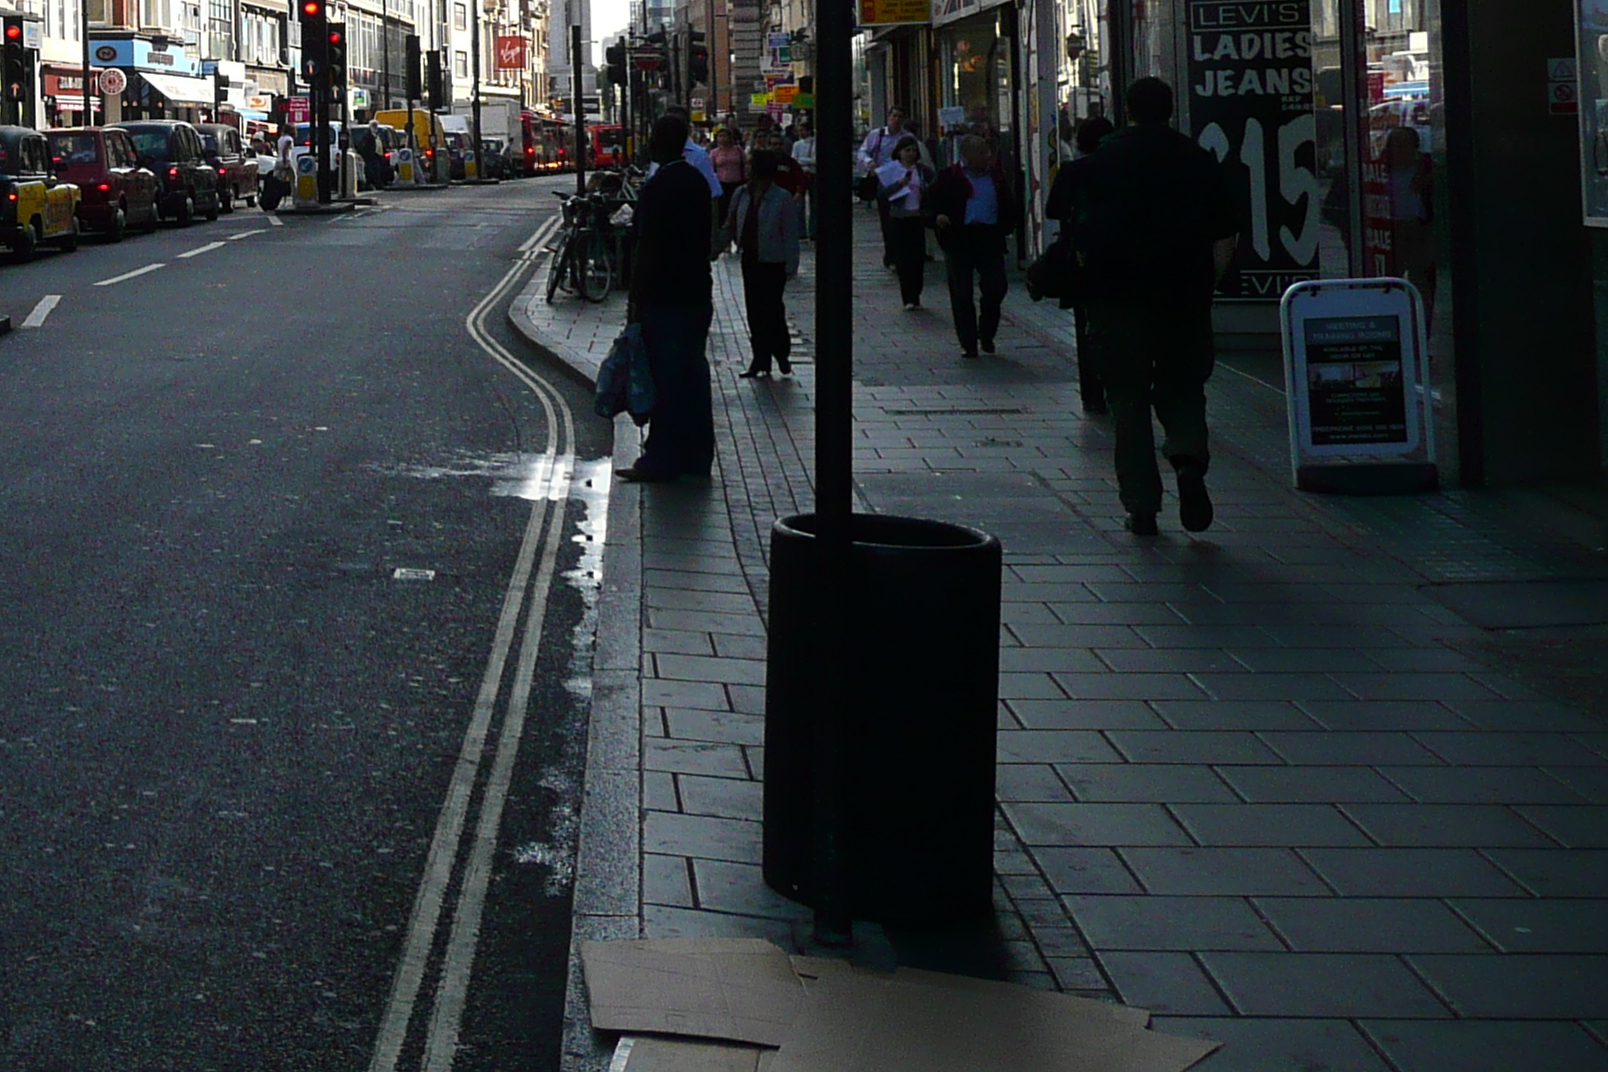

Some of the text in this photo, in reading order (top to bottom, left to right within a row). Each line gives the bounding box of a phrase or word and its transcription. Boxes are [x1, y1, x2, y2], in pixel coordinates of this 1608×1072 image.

[1199, 2, 1300, 27] LEVI'S
[1194, 31, 1312, 61] LADIES
[1195, 67, 1312, 97] JEANS
[1358, 330, 1392, 340] ROOMS
